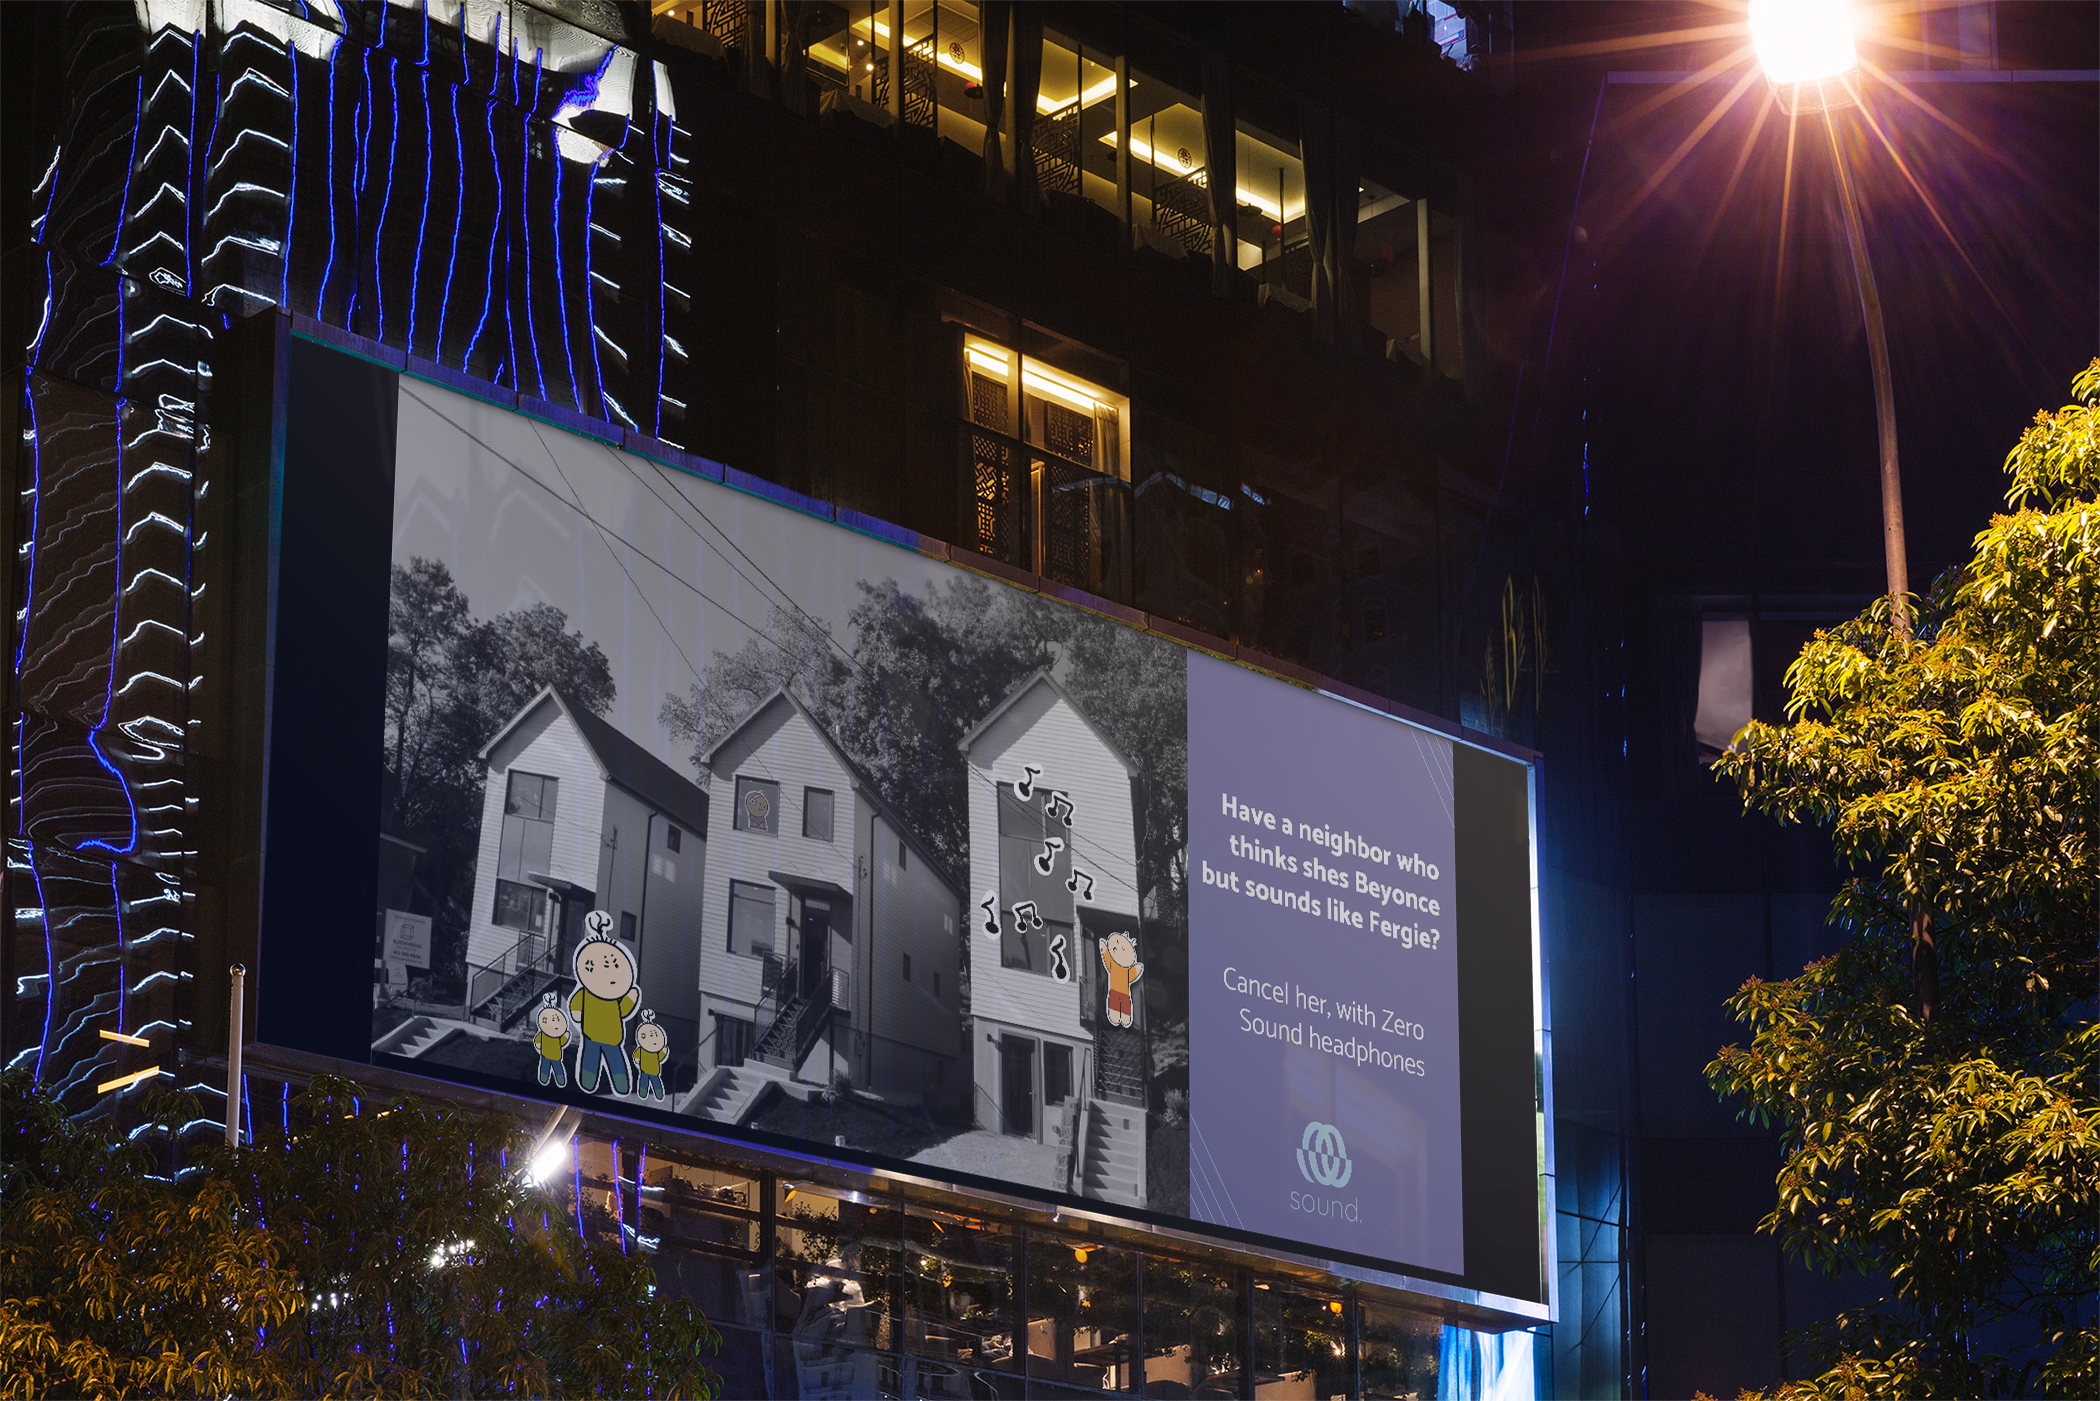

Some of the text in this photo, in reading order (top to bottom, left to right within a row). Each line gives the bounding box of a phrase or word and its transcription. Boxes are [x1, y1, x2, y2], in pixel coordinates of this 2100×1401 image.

[1221, 792, 1440, 881] Have a neighbor who
[1229, 834, 1441, 917] thinks shes Beyonce
[1202, 860, 1441, 951] but sounds like Fergie?
[1223, 966, 1425, 1041] Cancel her, with Zero
[1239, 1007, 1425, 1077] Sound headphones
